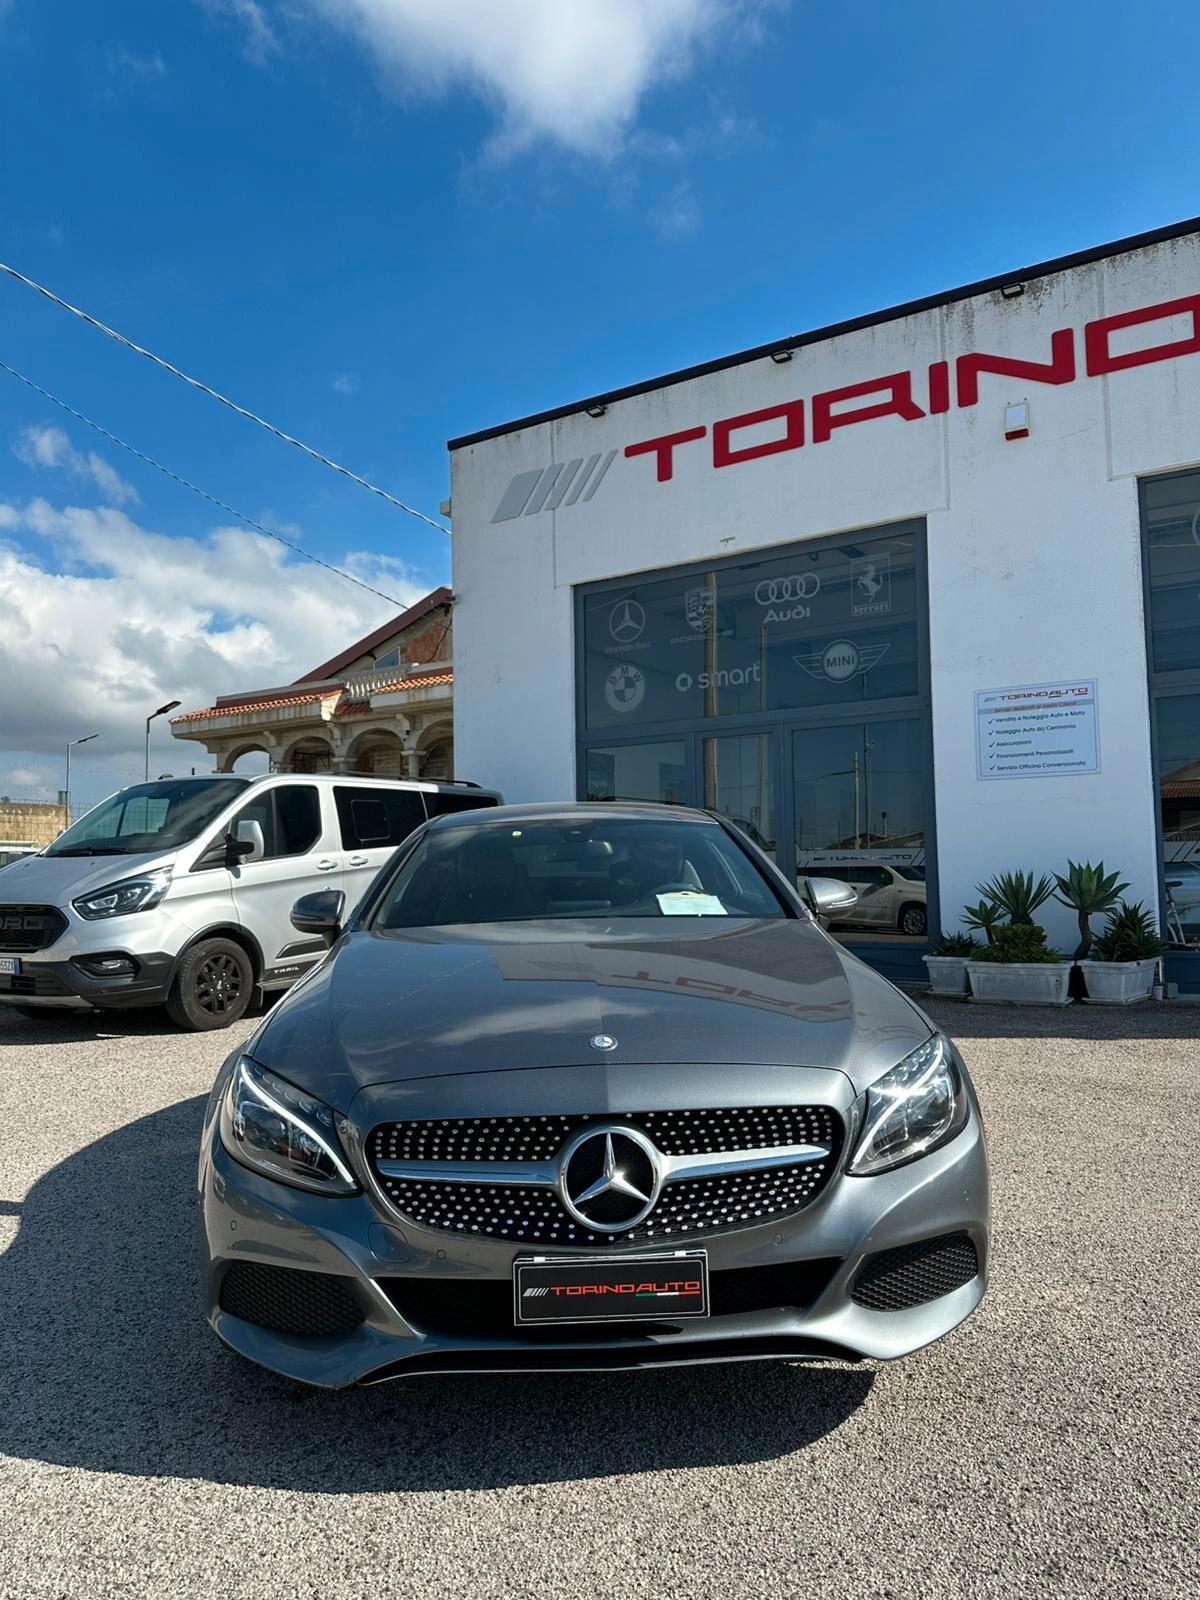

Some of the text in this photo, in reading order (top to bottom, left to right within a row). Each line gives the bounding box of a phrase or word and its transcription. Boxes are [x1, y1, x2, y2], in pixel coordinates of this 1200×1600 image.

[853, 600, 889, 614] Ferrari
[763, 605, 811, 623] Audi
[671, 630, 735, 645] PORSCHE
[826, 655, 855, 668] MINI
[698, 664, 762, 689] smart
[999, 687, 1088, 701] TORINOAUTO
[1023, 713, 1049, 722] Noleggio
[995, 727, 1021, 735] Noleggio
[1046, 723, 1076, 731] Cerimonia
[996, 739, 1032, 747] Assicurazioni
[997, 763, 1018, 771] Servizio
[1019, 761, 1041, 770] Officina
[274, 965, 300, 975] TRAIL
[550, 1281, 701, 1296] TORINOAUTO
